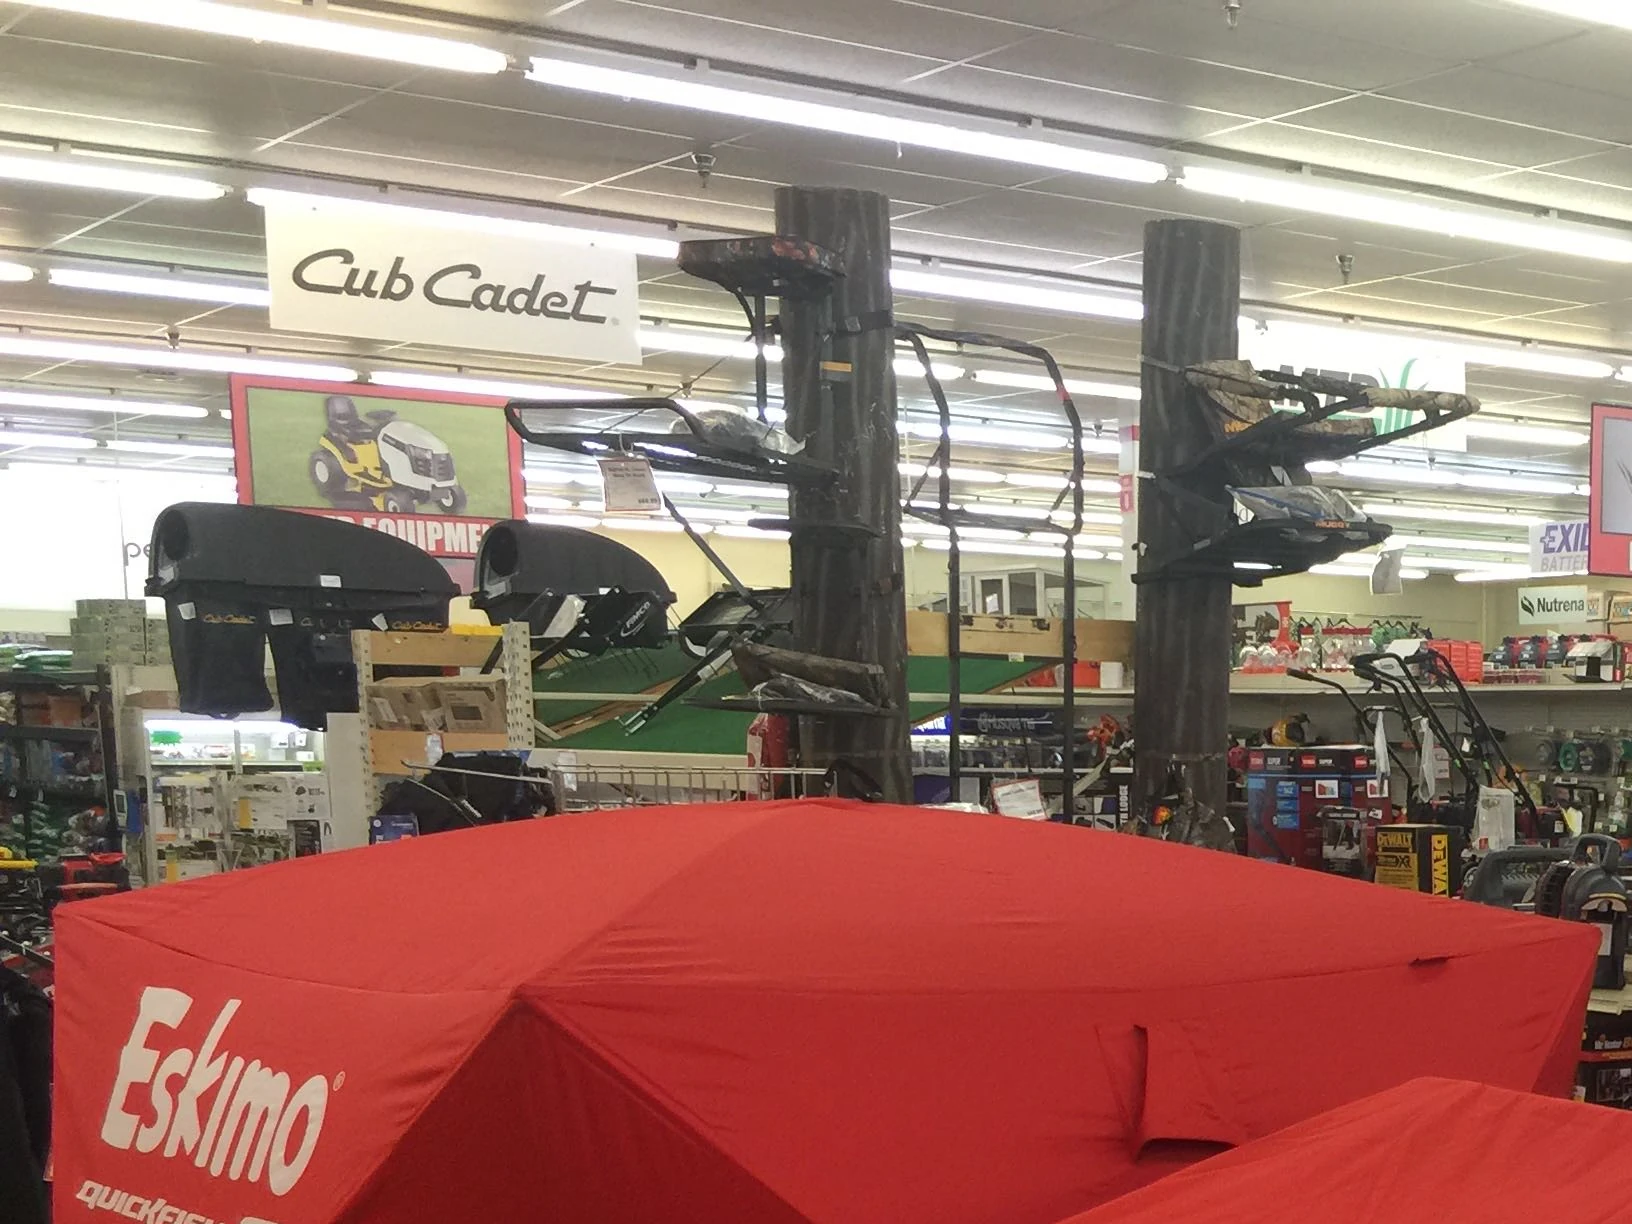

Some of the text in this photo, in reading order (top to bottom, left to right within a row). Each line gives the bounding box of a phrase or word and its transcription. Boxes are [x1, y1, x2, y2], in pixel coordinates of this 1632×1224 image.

[292, 248, 617, 325] Cub Cadet
[1537, 597, 1585, 612] Nutrena
[101, 986, 328, 1196] Eskimo
